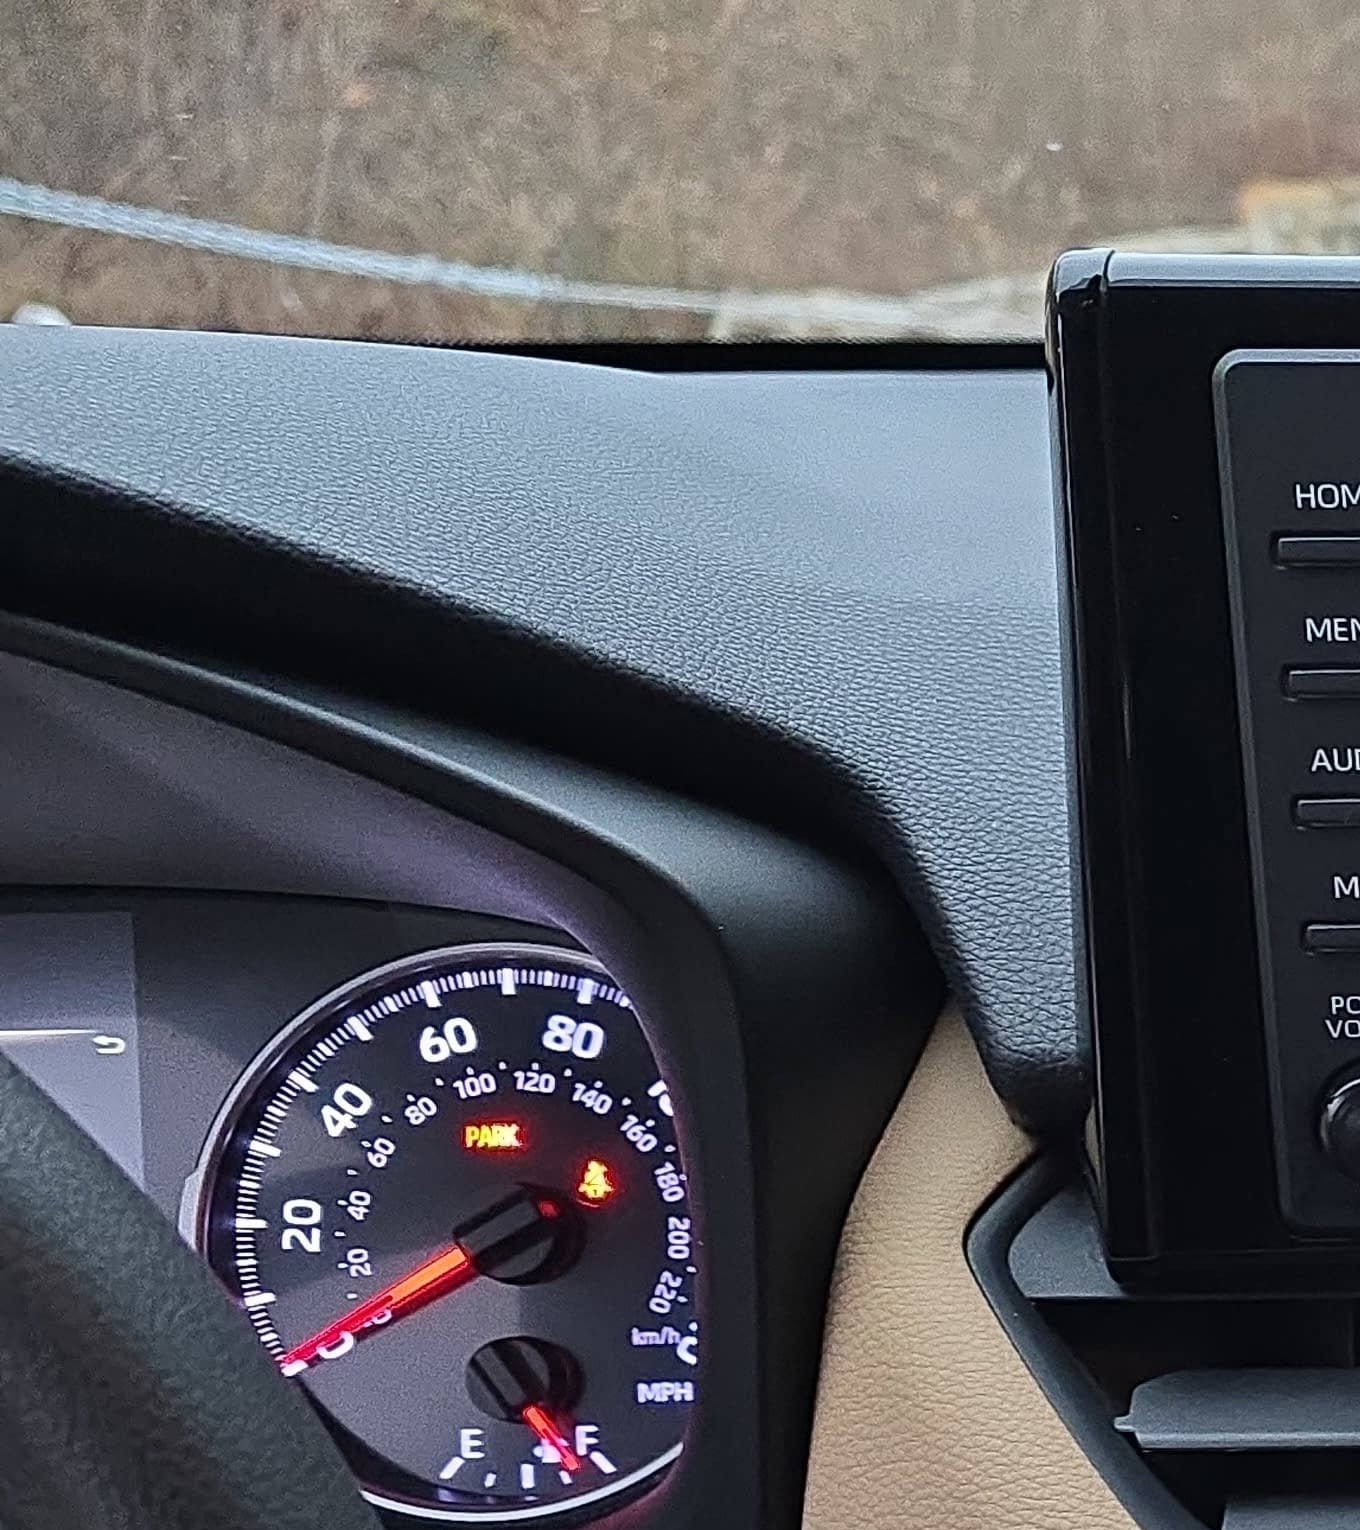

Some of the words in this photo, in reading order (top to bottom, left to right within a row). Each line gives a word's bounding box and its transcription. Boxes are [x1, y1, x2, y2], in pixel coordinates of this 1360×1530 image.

[419, 1017, 478, 1063] 60
[542, 1014, 605, 1059] 80
[452, 1072, 497, 1099] 100
[513, 1071, 556, 1094] 120
[319, 1082, 373, 1138] 40
[404, 1097, 437, 1125] 80
[572, 1082, 613, 1115] 140
[464, 1123, 520, 1149] PARK
[620, 1114, 658, 1153] 160
[367, 1137, 396, 1168] 60
[654, 1161, 685, 1202] 180
[350, 1190, 371, 1221] 40
[281, 1198, 323, 1253] 20
[667, 1216, 691, 1260] 200
[350, 1248, 372, 1277] 20
[637, 1381, 694, 1403] MPH
[459, 1428, 485, 1458] E
[575, 1424, 599, 1456] F
